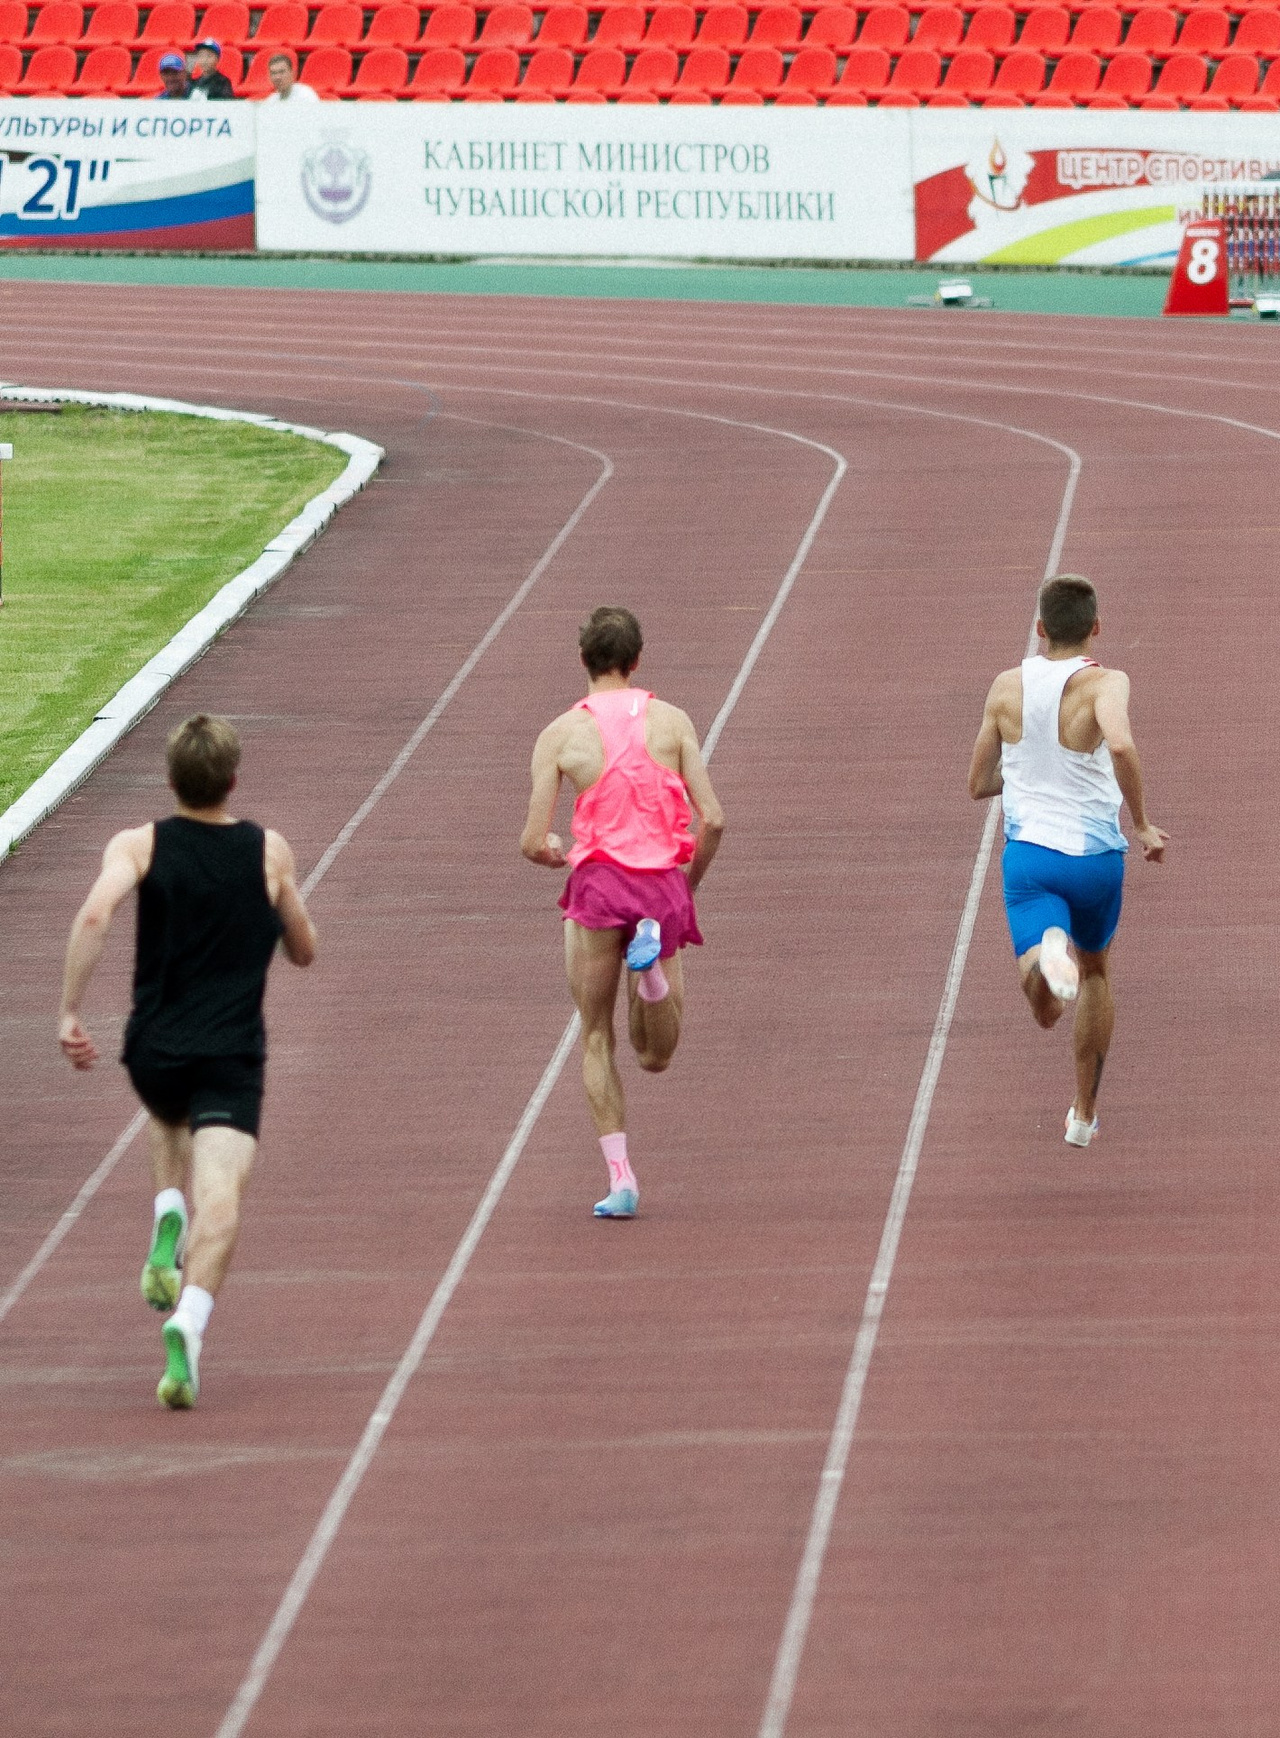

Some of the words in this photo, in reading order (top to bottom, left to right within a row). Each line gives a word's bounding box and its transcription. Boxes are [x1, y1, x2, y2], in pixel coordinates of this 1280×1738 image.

[112, 118, 127, 137] И
[136, 118, 232, 138] СПОРТА
[424, 140, 568, 172] КАБИНЕТ
[578, 141, 770, 174] МИНИСТРОВ
[1061, 156, 1141, 182] ЦЕНТР
[424, 181, 625, 218] ЧУВАШСКОЙ
[636, 189, 836, 221] РЕСПУБЛИКИ
[1187, 239, 1219, 284] 8
